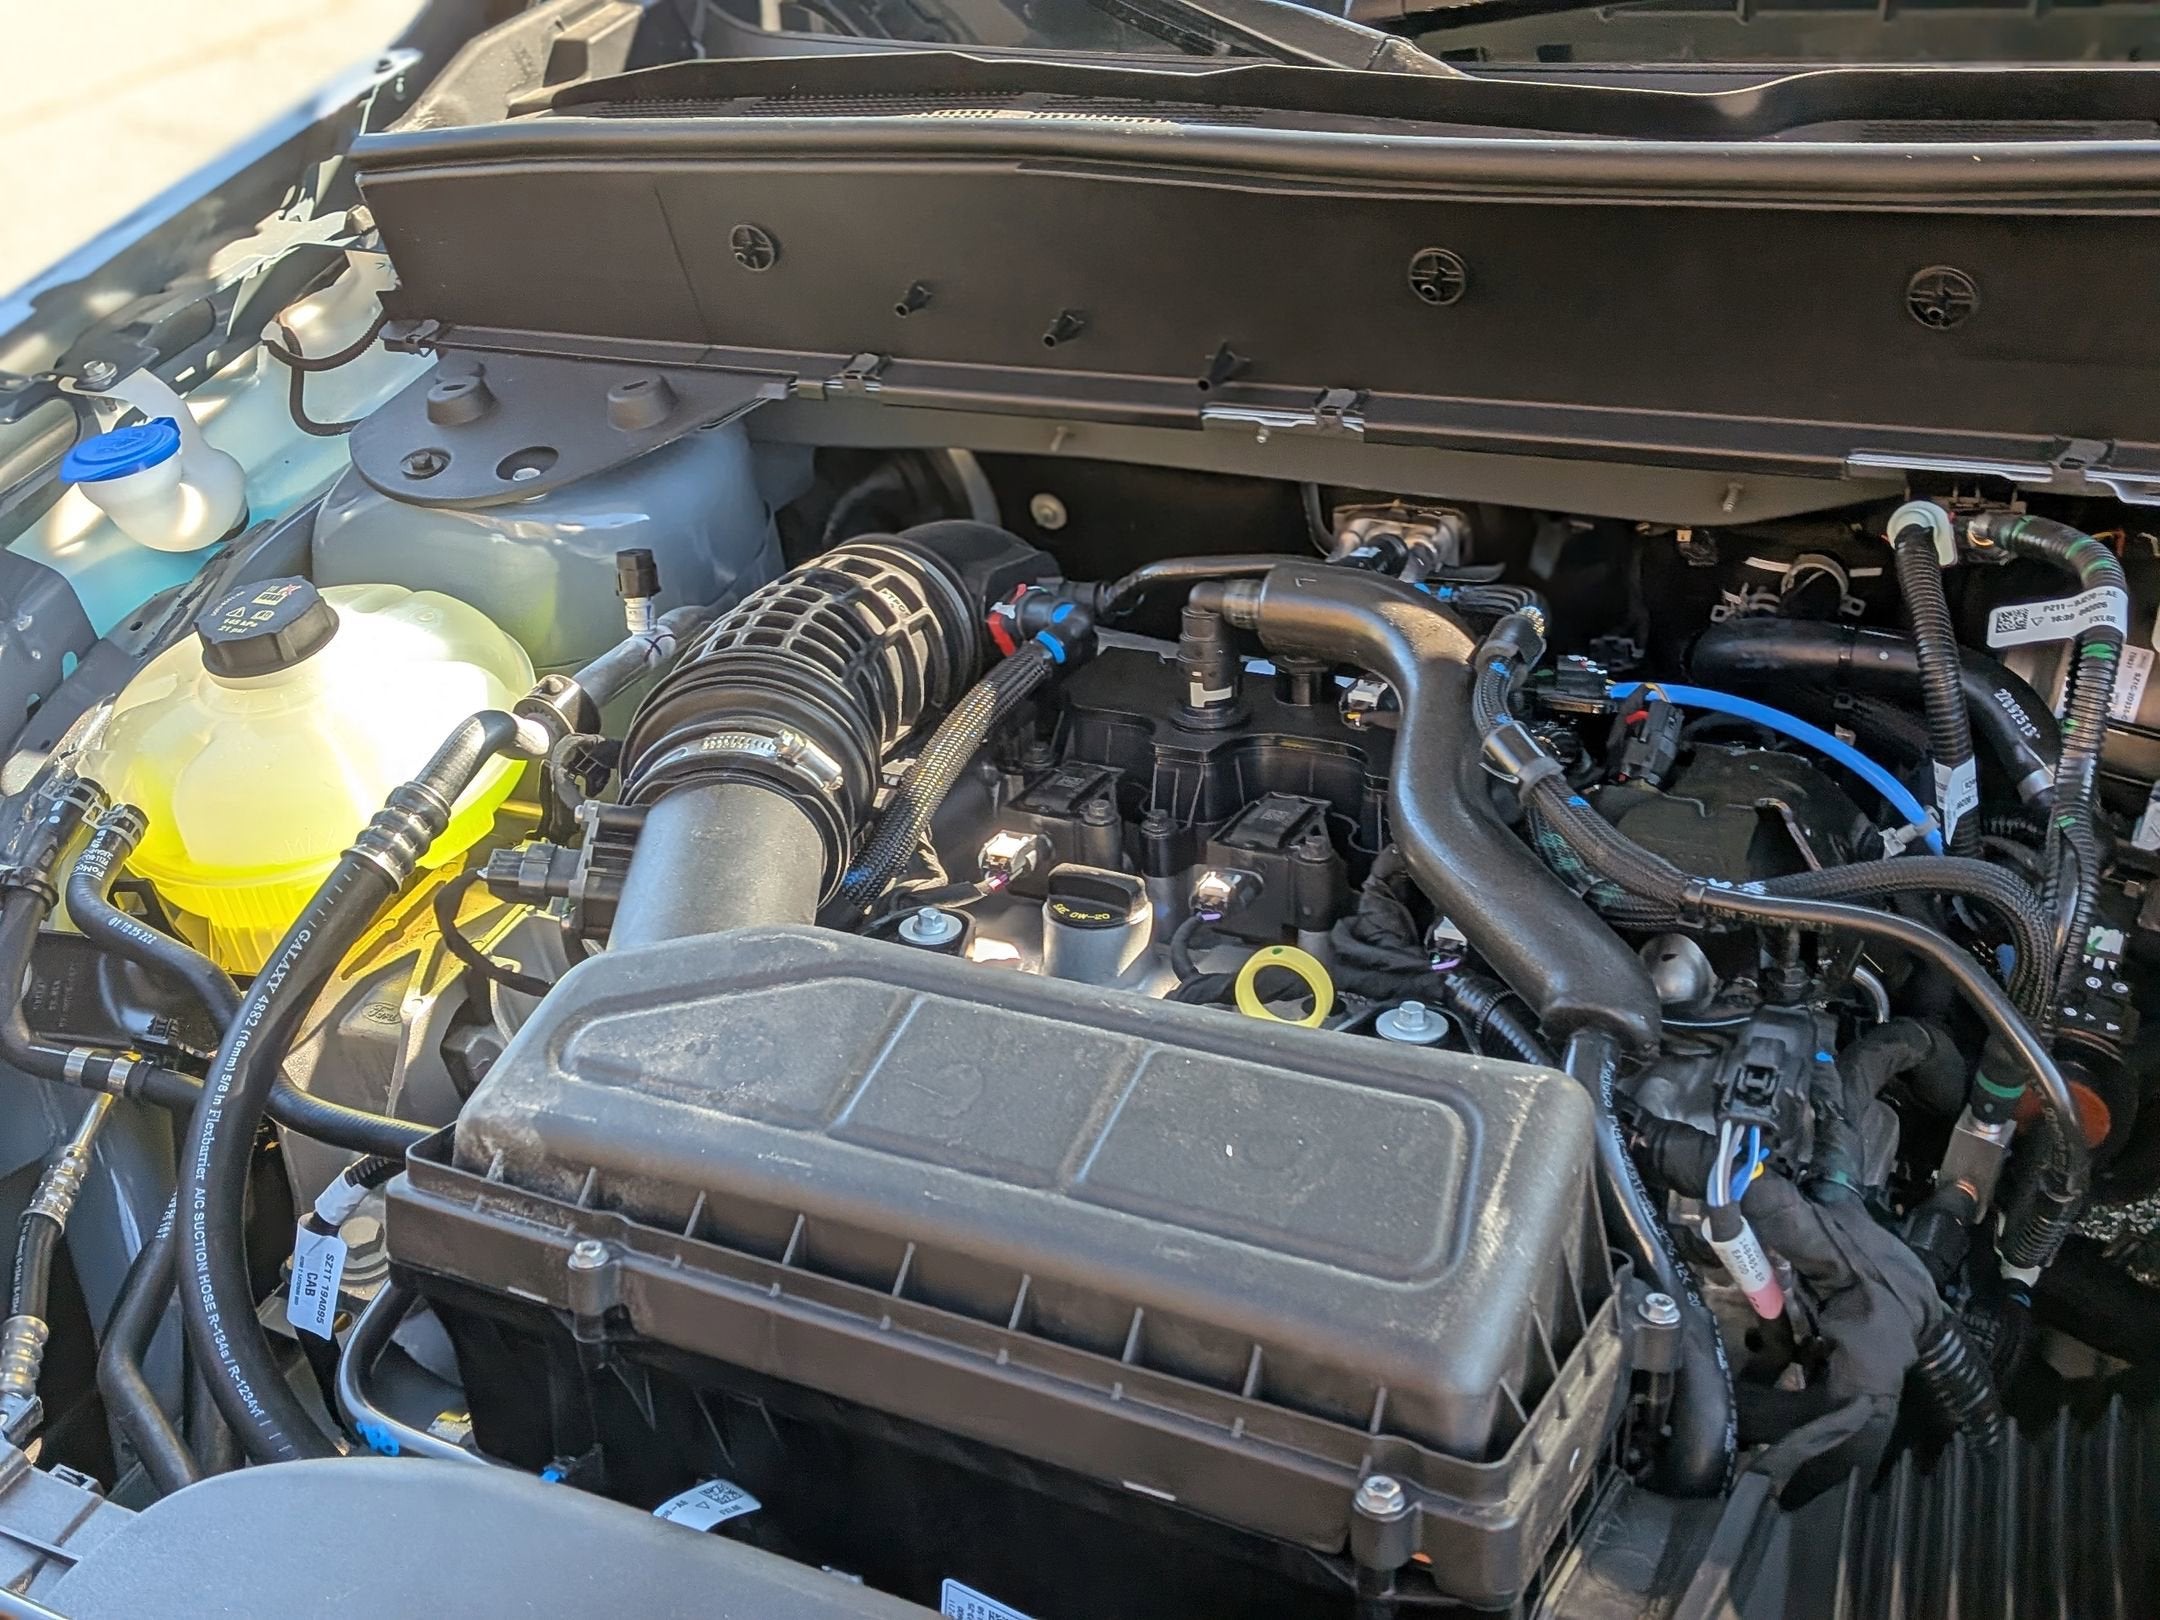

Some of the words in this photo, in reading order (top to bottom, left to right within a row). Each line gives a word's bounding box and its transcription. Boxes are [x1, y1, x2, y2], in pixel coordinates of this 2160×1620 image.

[266, 929, 312, 994] GALAXY
[245, 994, 270, 1028] 4882
[225, 1029, 252, 1072] (16mm)
[217, 1073, 233, 1092] 5/8
[195, 1109, 223, 1181] Flexbarrier
[194, 1187, 206, 1209] A/C
[193, 1212, 208, 1273] SUCTION
[305, 1272, 319, 1297] CAB
[323, 1253, 335, 1282] SZ1T
[198, 1274, 218, 1313] HOSE
[316, 1285, 330, 1325] 19A095
[208, 1314, 230, 1358] R-134a
[228, 1364, 266, 1418] R-1234yf
